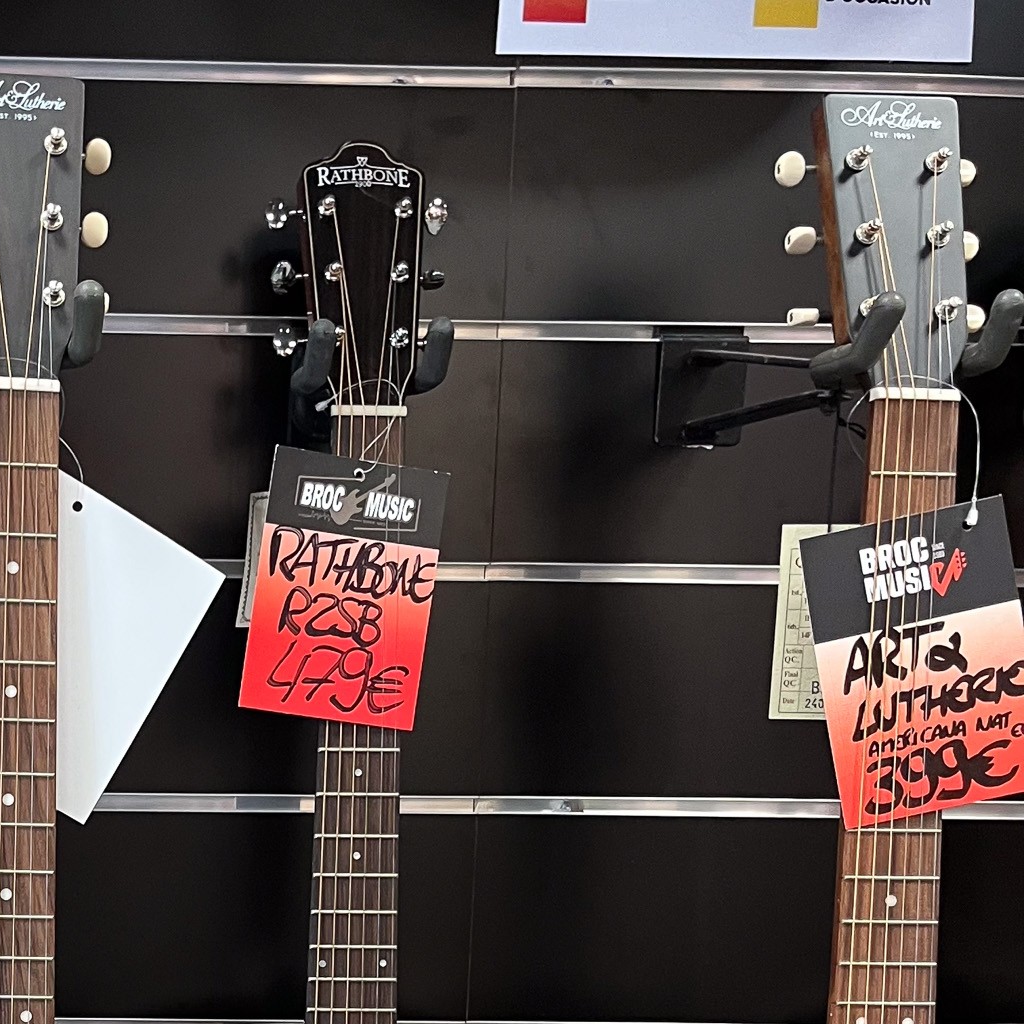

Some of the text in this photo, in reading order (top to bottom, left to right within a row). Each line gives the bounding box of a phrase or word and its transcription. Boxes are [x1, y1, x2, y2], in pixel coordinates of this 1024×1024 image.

[316, 167, 411, 188] RATHBONE
[299, 481, 345, 513] BROC
[364, 491, 416, 523] MUSIC
[858, 536, 930, 575] BROC
[266, 640, 410, 714] 479€
[864, 738, 1020, 815] 399€
